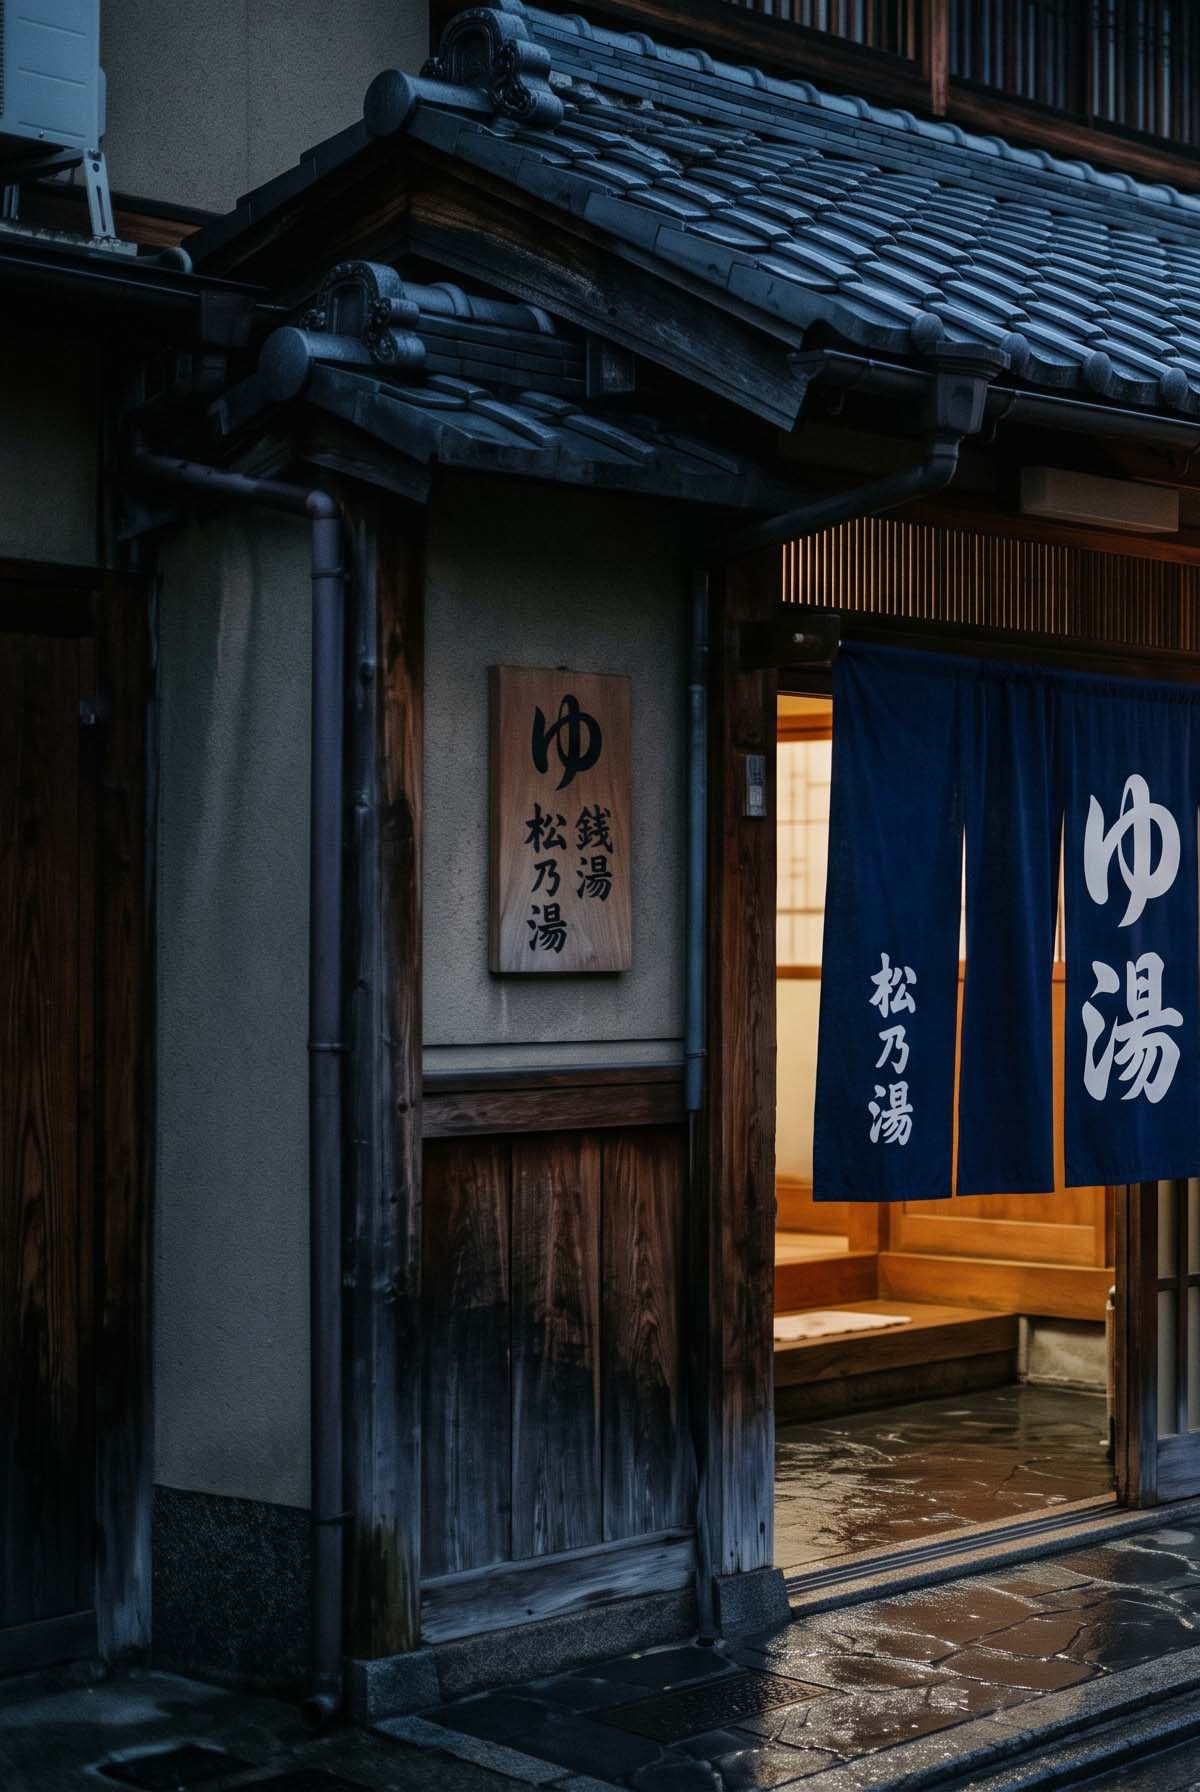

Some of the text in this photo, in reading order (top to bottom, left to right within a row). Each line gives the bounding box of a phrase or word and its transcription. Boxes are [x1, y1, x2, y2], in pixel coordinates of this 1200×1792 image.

[532, 694, 602, 790] ゆ
[525, 803, 567, 953] 松乃湯
[575, 804, 613, 901] 銭湯
[1082, 774, 1184, 1104] ゆ湯
[868, 953, 917, 1146] 松乃湯
